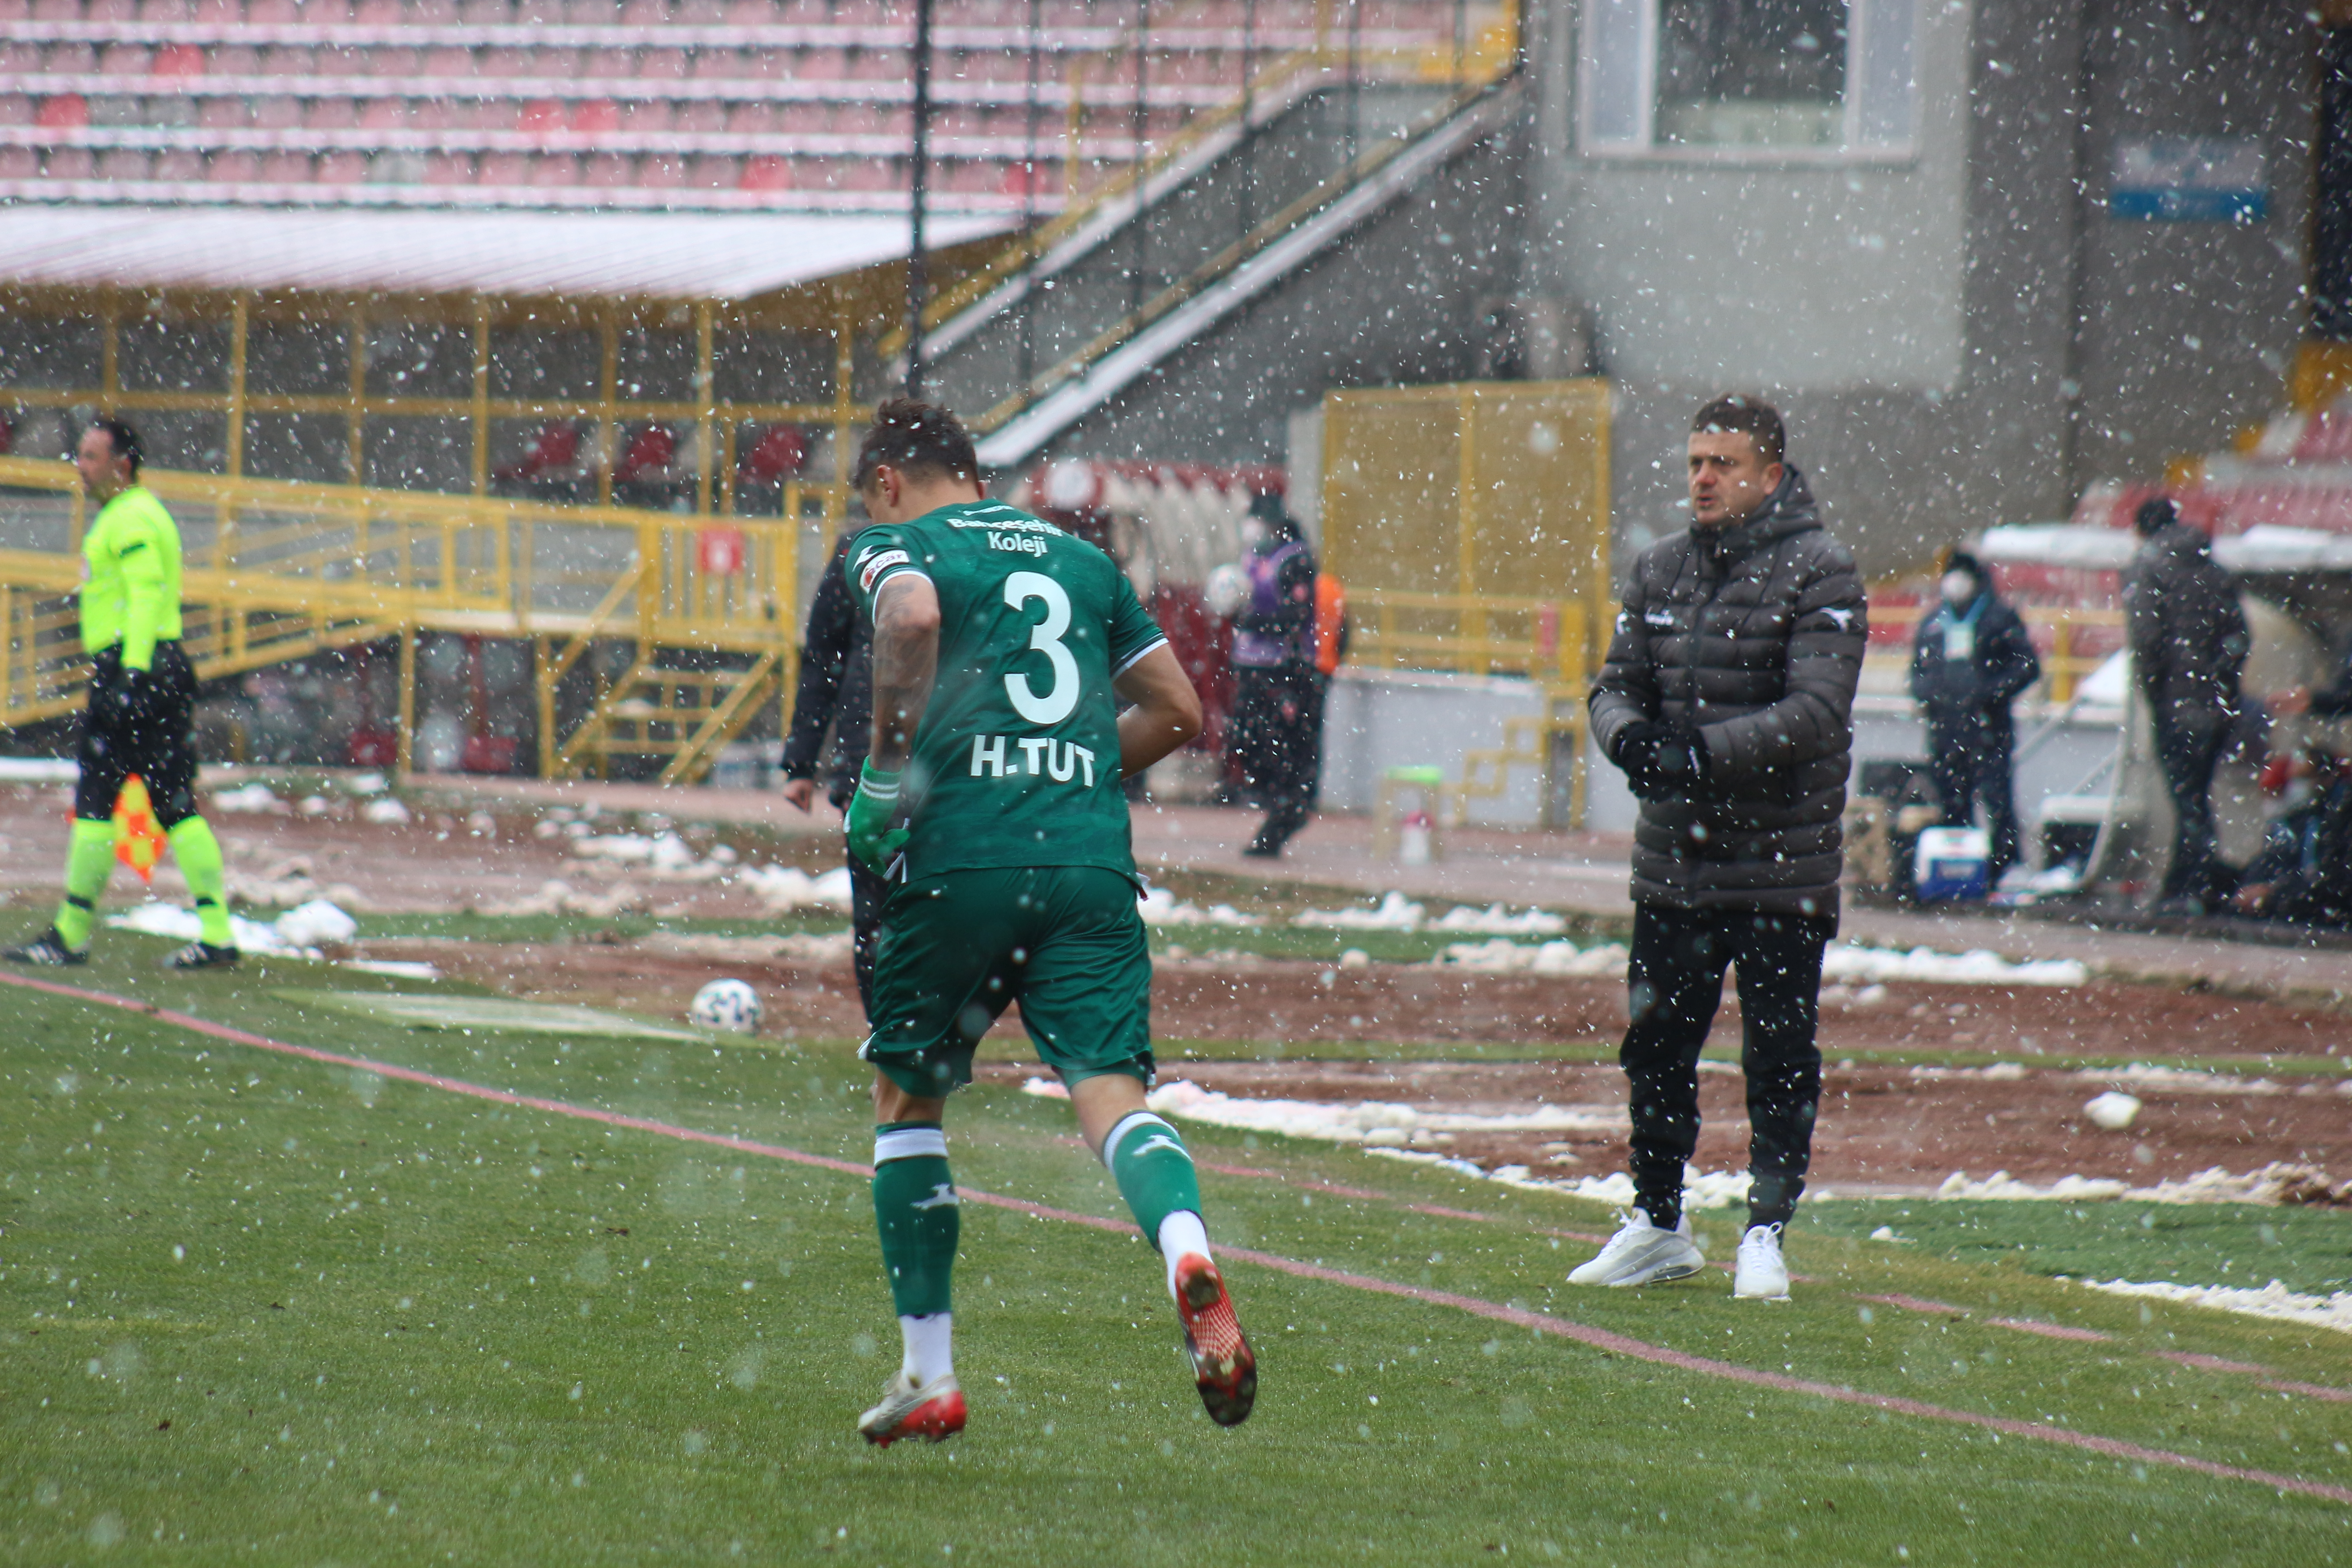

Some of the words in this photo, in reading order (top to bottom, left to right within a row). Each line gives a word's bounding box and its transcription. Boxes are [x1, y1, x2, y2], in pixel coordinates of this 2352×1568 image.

[987, 531, 1048, 558] Koleji
[1004, 571, 1080, 725] 3
[970, 734, 1095, 787] H.TUT
